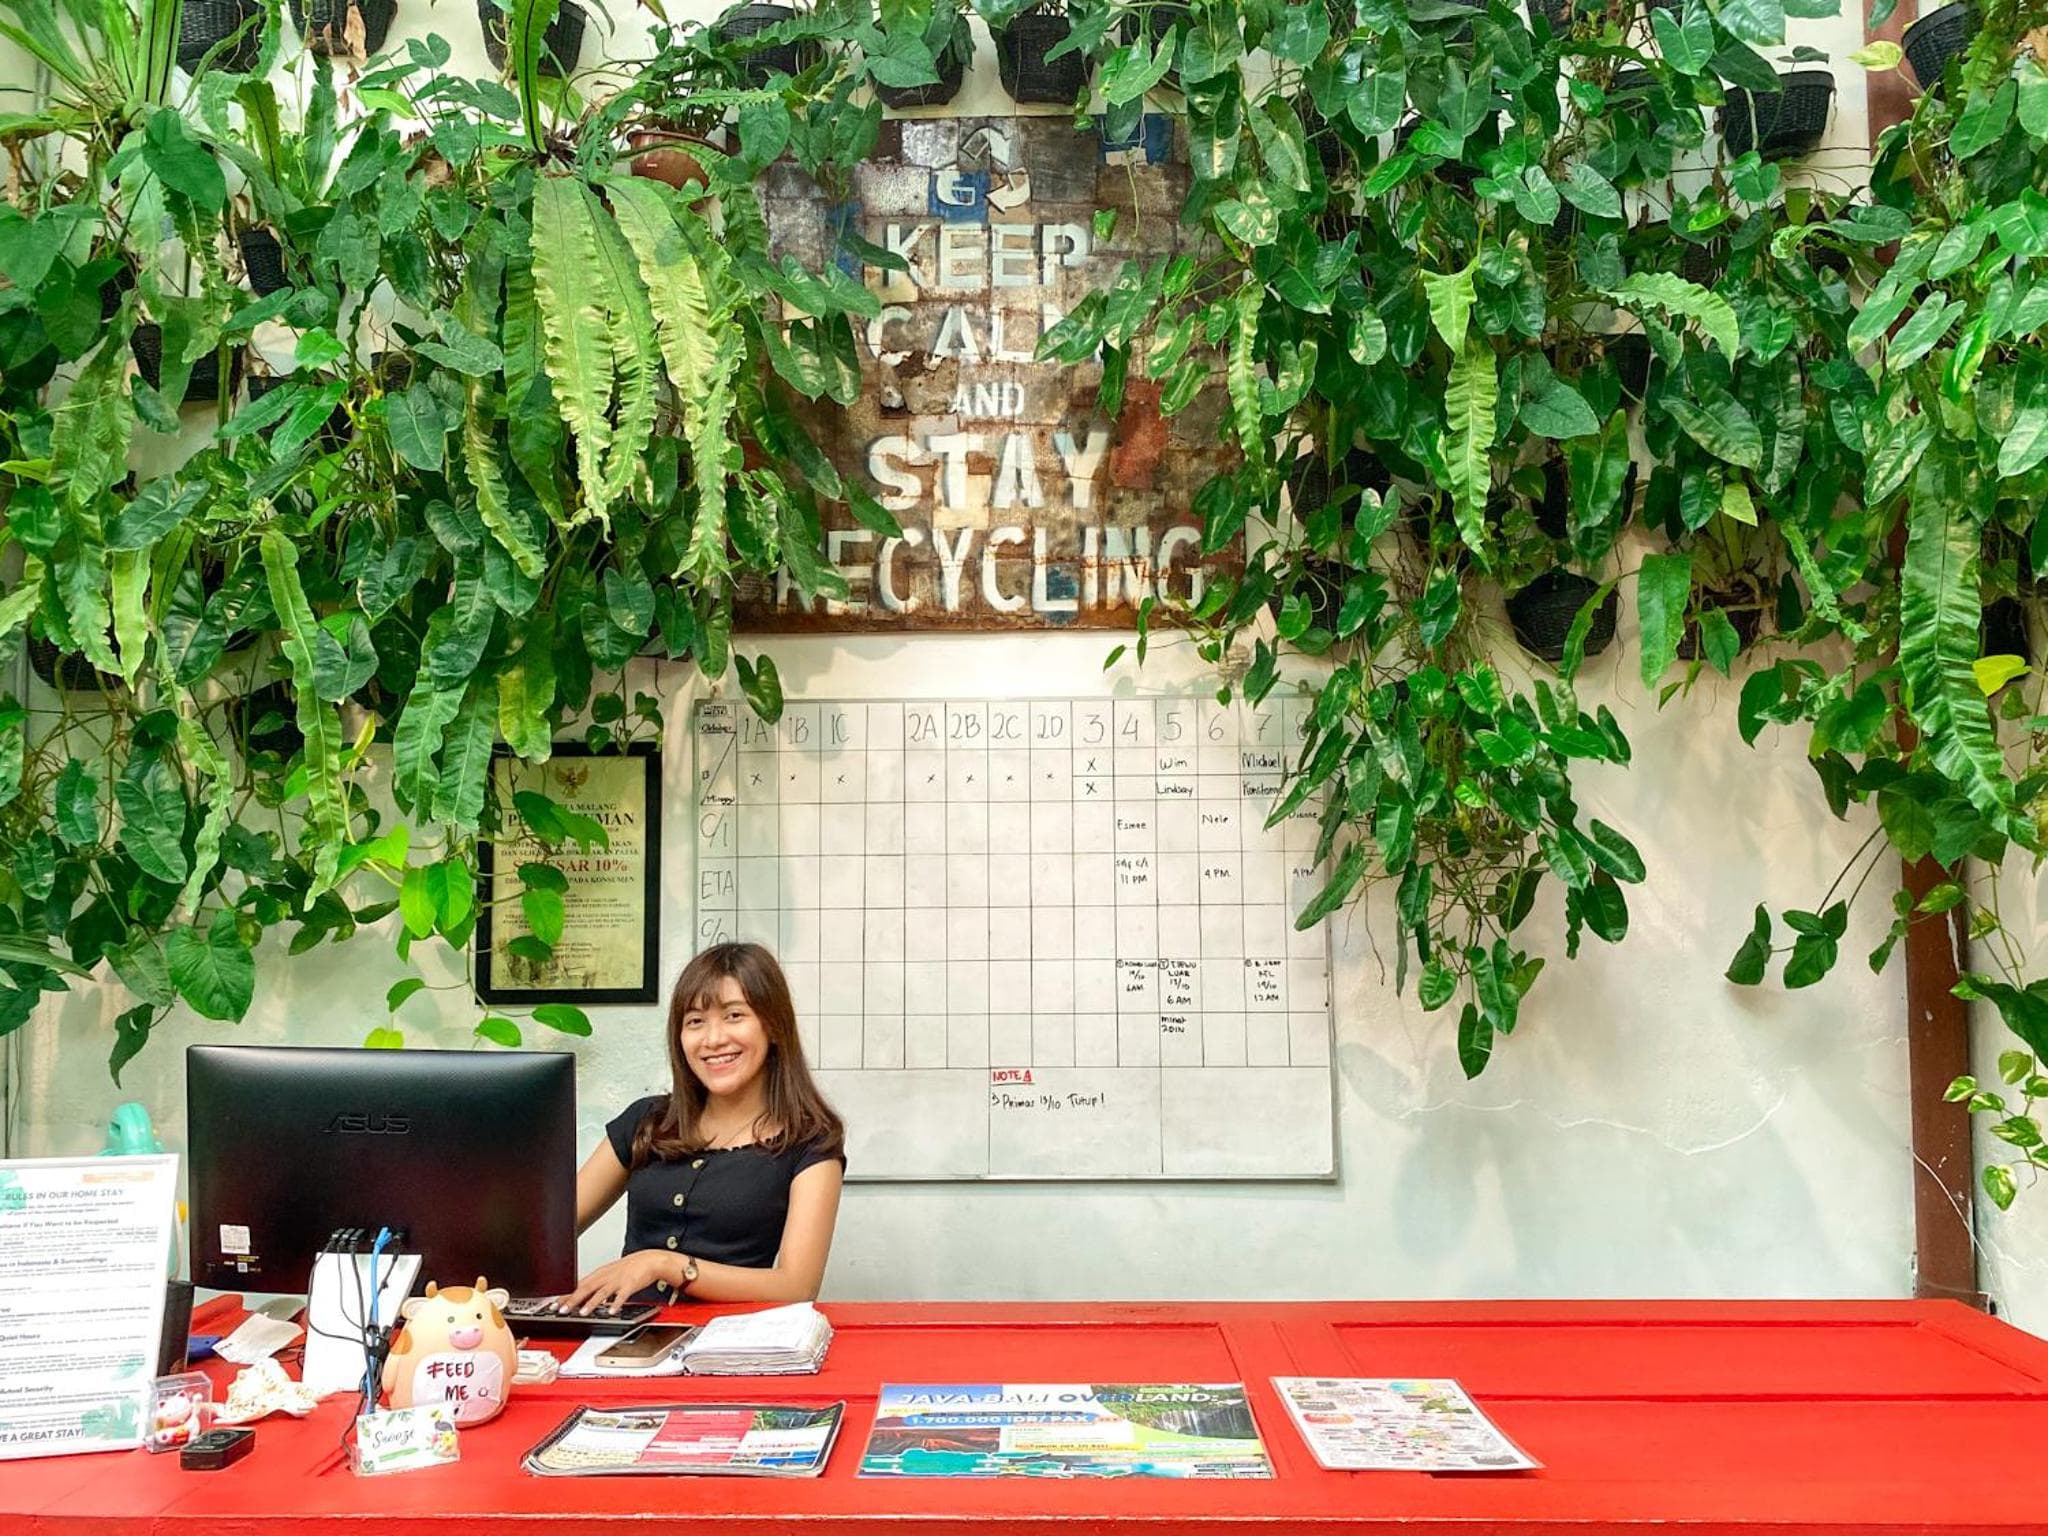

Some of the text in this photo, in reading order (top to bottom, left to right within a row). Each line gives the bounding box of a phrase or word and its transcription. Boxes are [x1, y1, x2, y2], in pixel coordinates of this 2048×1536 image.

[885, 223, 1089, 288] KEEP
[951, 381, 1026, 417] AND
[868, 431, 1109, 511] STAY
[743, 717, 768, 744] 1A
[787, 716, 810, 744] 1B
[831, 713, 851, 744] 1C
[908, 712, 938, 742] 2A
[951, 712, 981, 741] 2B
[992, 713, 1022, 739] 2C
[1083, 714, 1105, 743] 3
[1121, 713, 1139, 742] 4
[1162, 712, 1182, 741] 5
[1208, 712, 1225, 741] 6
[1253, 712, 1272, 742] 7
[1241, 752, 1281, 768] Michael
[595, 859, 628, 872] 10%
[701, 870, 734, 900] ETA
[993, 1070, 1021, 1081] NOTE
[320, 1112, 411, 1135] ASUS
[49, 1191, 69, 1199] OUR
[71, 1190, 97, 1198] HOME
[100, 1189, 124, 1197] STAY
[427, 1361, 475, 1379] FEED
[445, 1385, 469, 1401] ME
[20, 1430, 53, 1442] GREAT
